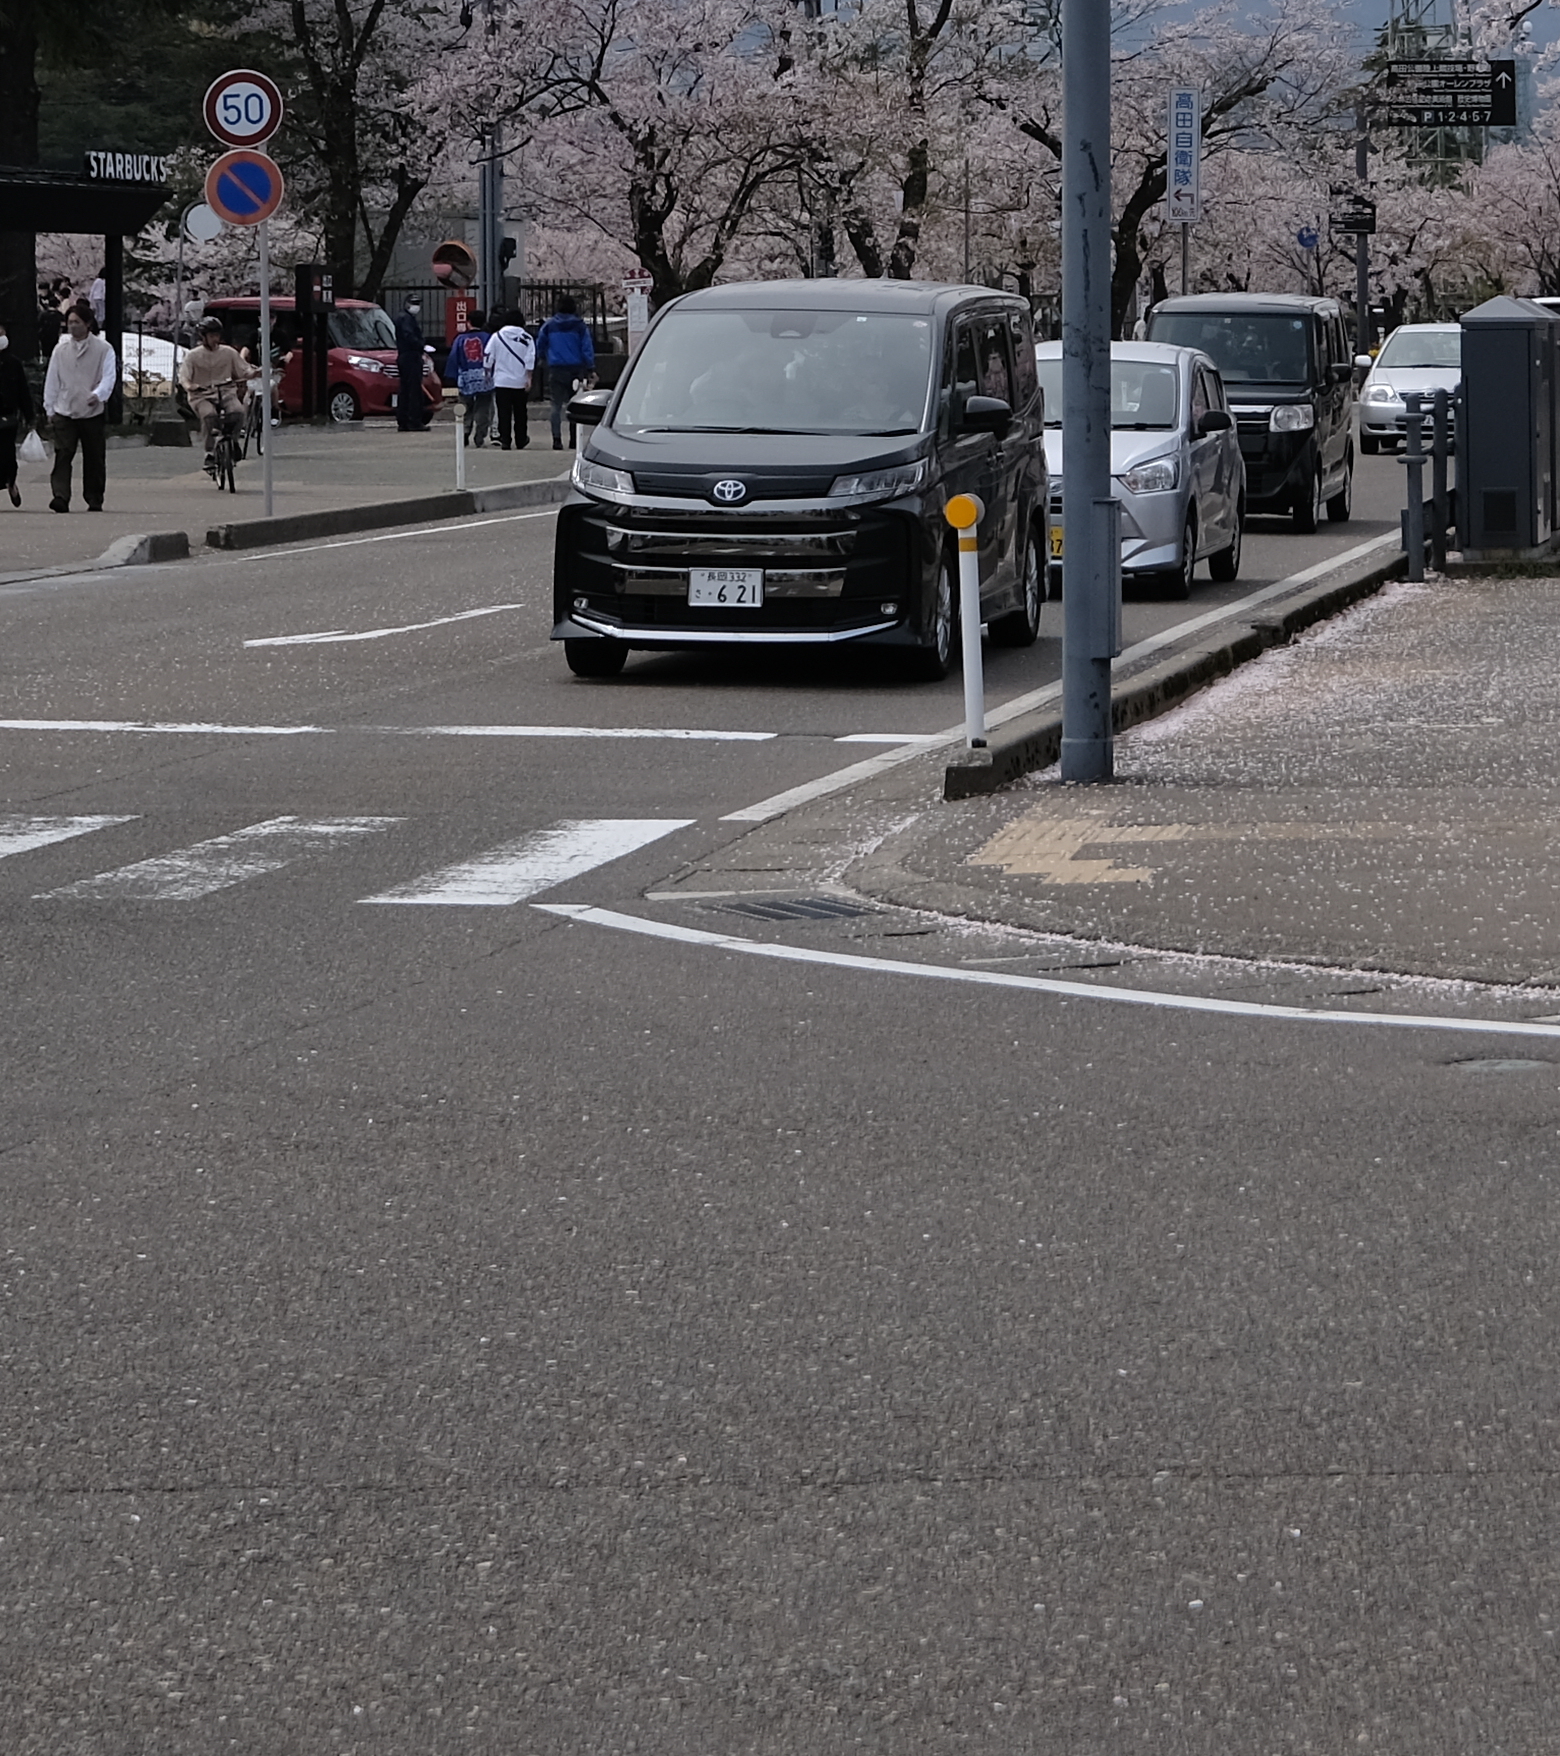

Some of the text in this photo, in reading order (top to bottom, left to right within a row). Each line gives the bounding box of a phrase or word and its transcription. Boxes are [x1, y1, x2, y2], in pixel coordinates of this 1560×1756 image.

[222, 93, 264, 125] 50
[1174, 92, 1194, 186] 高田自衛隊
[89, 150, 167, 183] STARBUCKS
